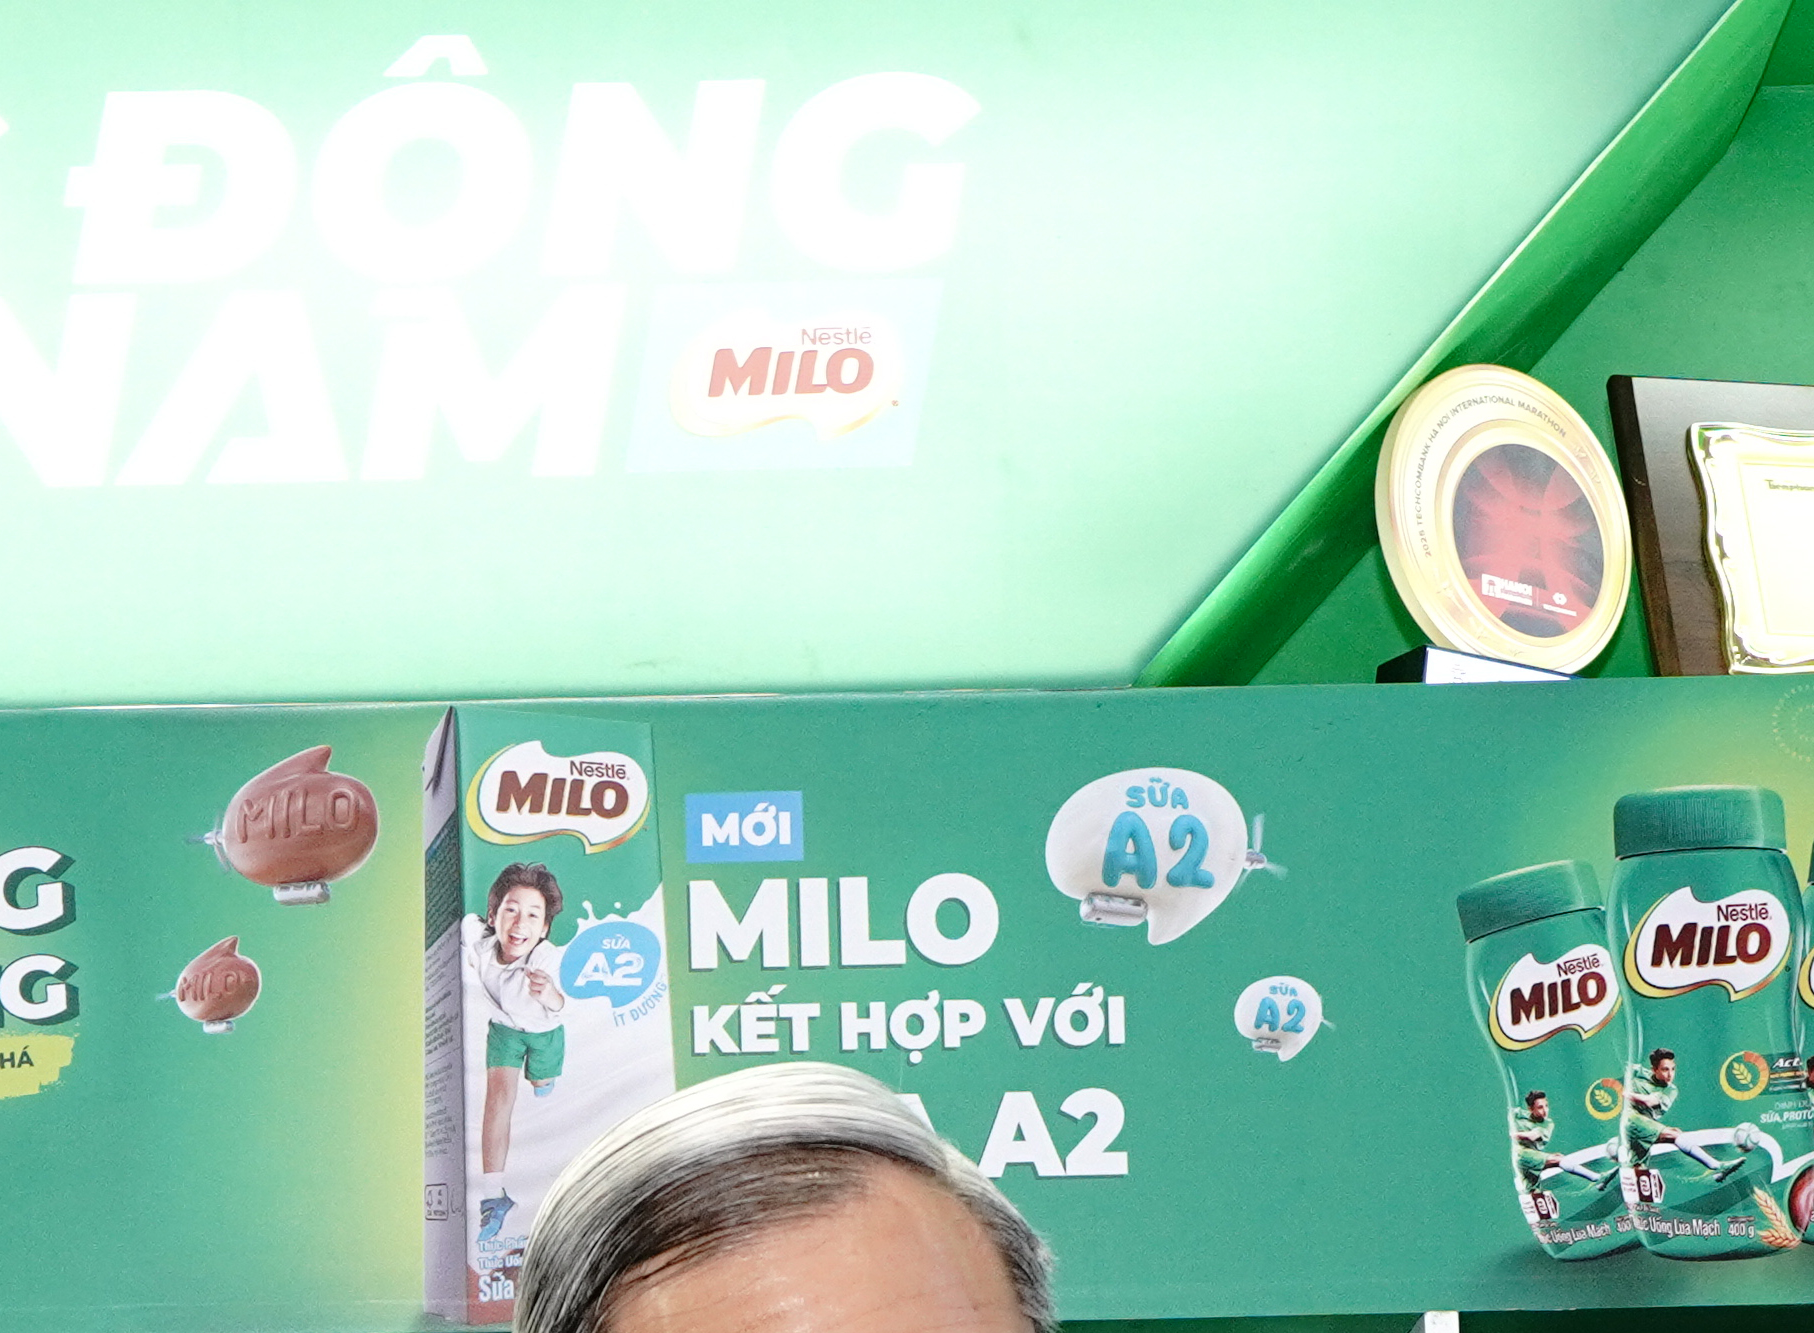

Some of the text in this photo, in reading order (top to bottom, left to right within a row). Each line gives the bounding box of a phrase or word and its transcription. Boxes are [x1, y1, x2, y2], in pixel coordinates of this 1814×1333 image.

[708, 347, 874, 397] MILO
[1450, 395, 1515, 417] INTERNATIONAL
[1518, 401, 1566, 438] MARATHON
[237, 787, 360, 844] MILO
[496, 770, 630, 819] MILO
[1125, 776, 1190, 811] SỮA
[700, 802, 792, 847] MỚI
[1101, 810, 1215, 890] A2
[688, 872, 1000, 970] MILO
[1650, 921, 1772, 968] MILO
[574, 952, 644, 987] A2
[692, 981, 1127, 1065] KẾT HỢP VỚI
[1253, 996, 1307, 1035] A2
[1510, 971, 1607, 1026] MILO
[978, 1087, 1129, 1178] A2
[479, 1273, 515, 1302] Sữa
